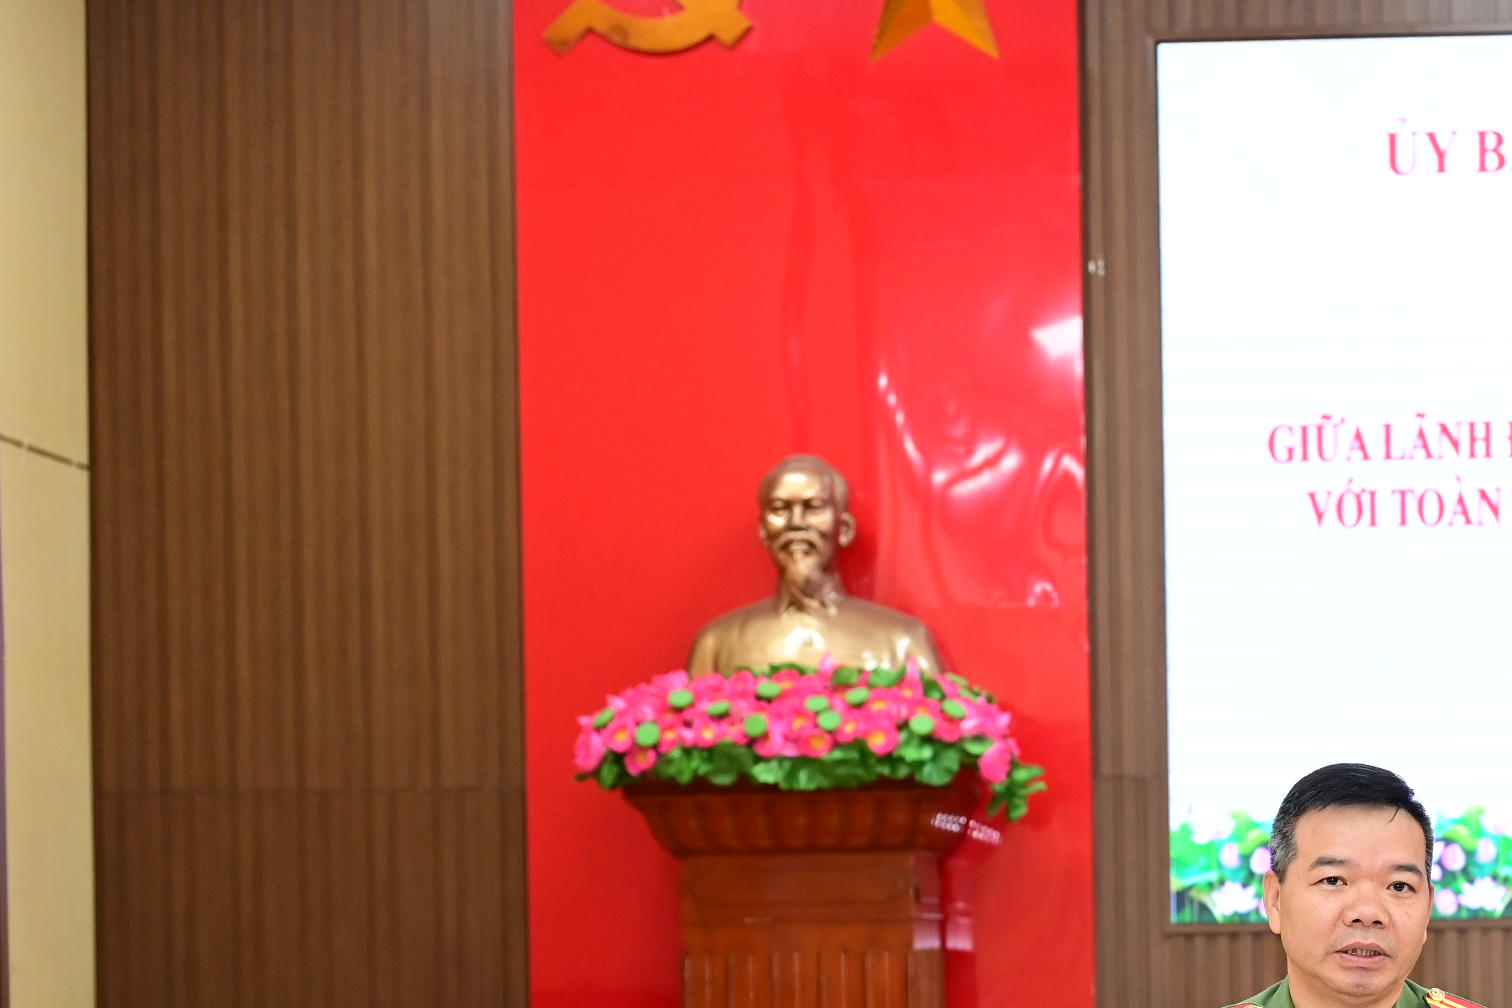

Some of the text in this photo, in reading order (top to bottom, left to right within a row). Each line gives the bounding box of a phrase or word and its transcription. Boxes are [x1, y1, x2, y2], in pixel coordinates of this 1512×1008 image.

[1386, 118, 1457, 176] ỦY
[1267, 413, 1372, 464] GIỮA
[1382, 411, 1493, 461] LÃNH
[1306, 477, 1378, 529] VỚI
[1391, 475, 1502, 527] TOÀN
